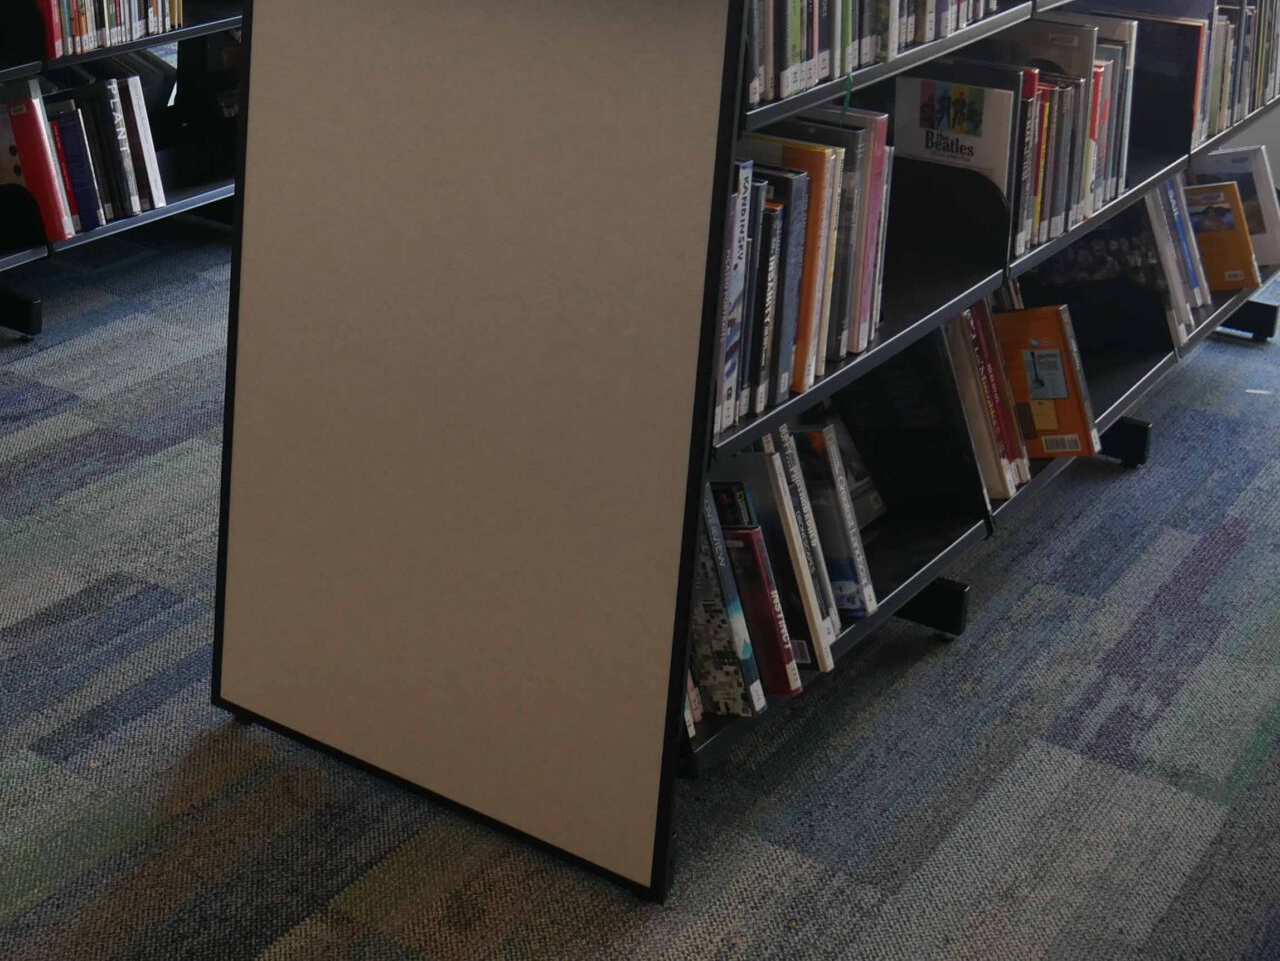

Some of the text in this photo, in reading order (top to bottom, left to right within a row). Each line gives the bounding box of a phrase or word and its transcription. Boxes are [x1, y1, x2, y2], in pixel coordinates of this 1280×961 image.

[106, 83, 130, 156] PLANT
[924, 130, 975, 157] Beatles
[732, 175, 753, 261] KANDINSKY
[760, 255, 778, 324] INSANITY
[698, 499, 730, 569] OVERVIEW
[832, 475, 859, 528] Greatest
[769, 589, 792, 651] INSTINCT
